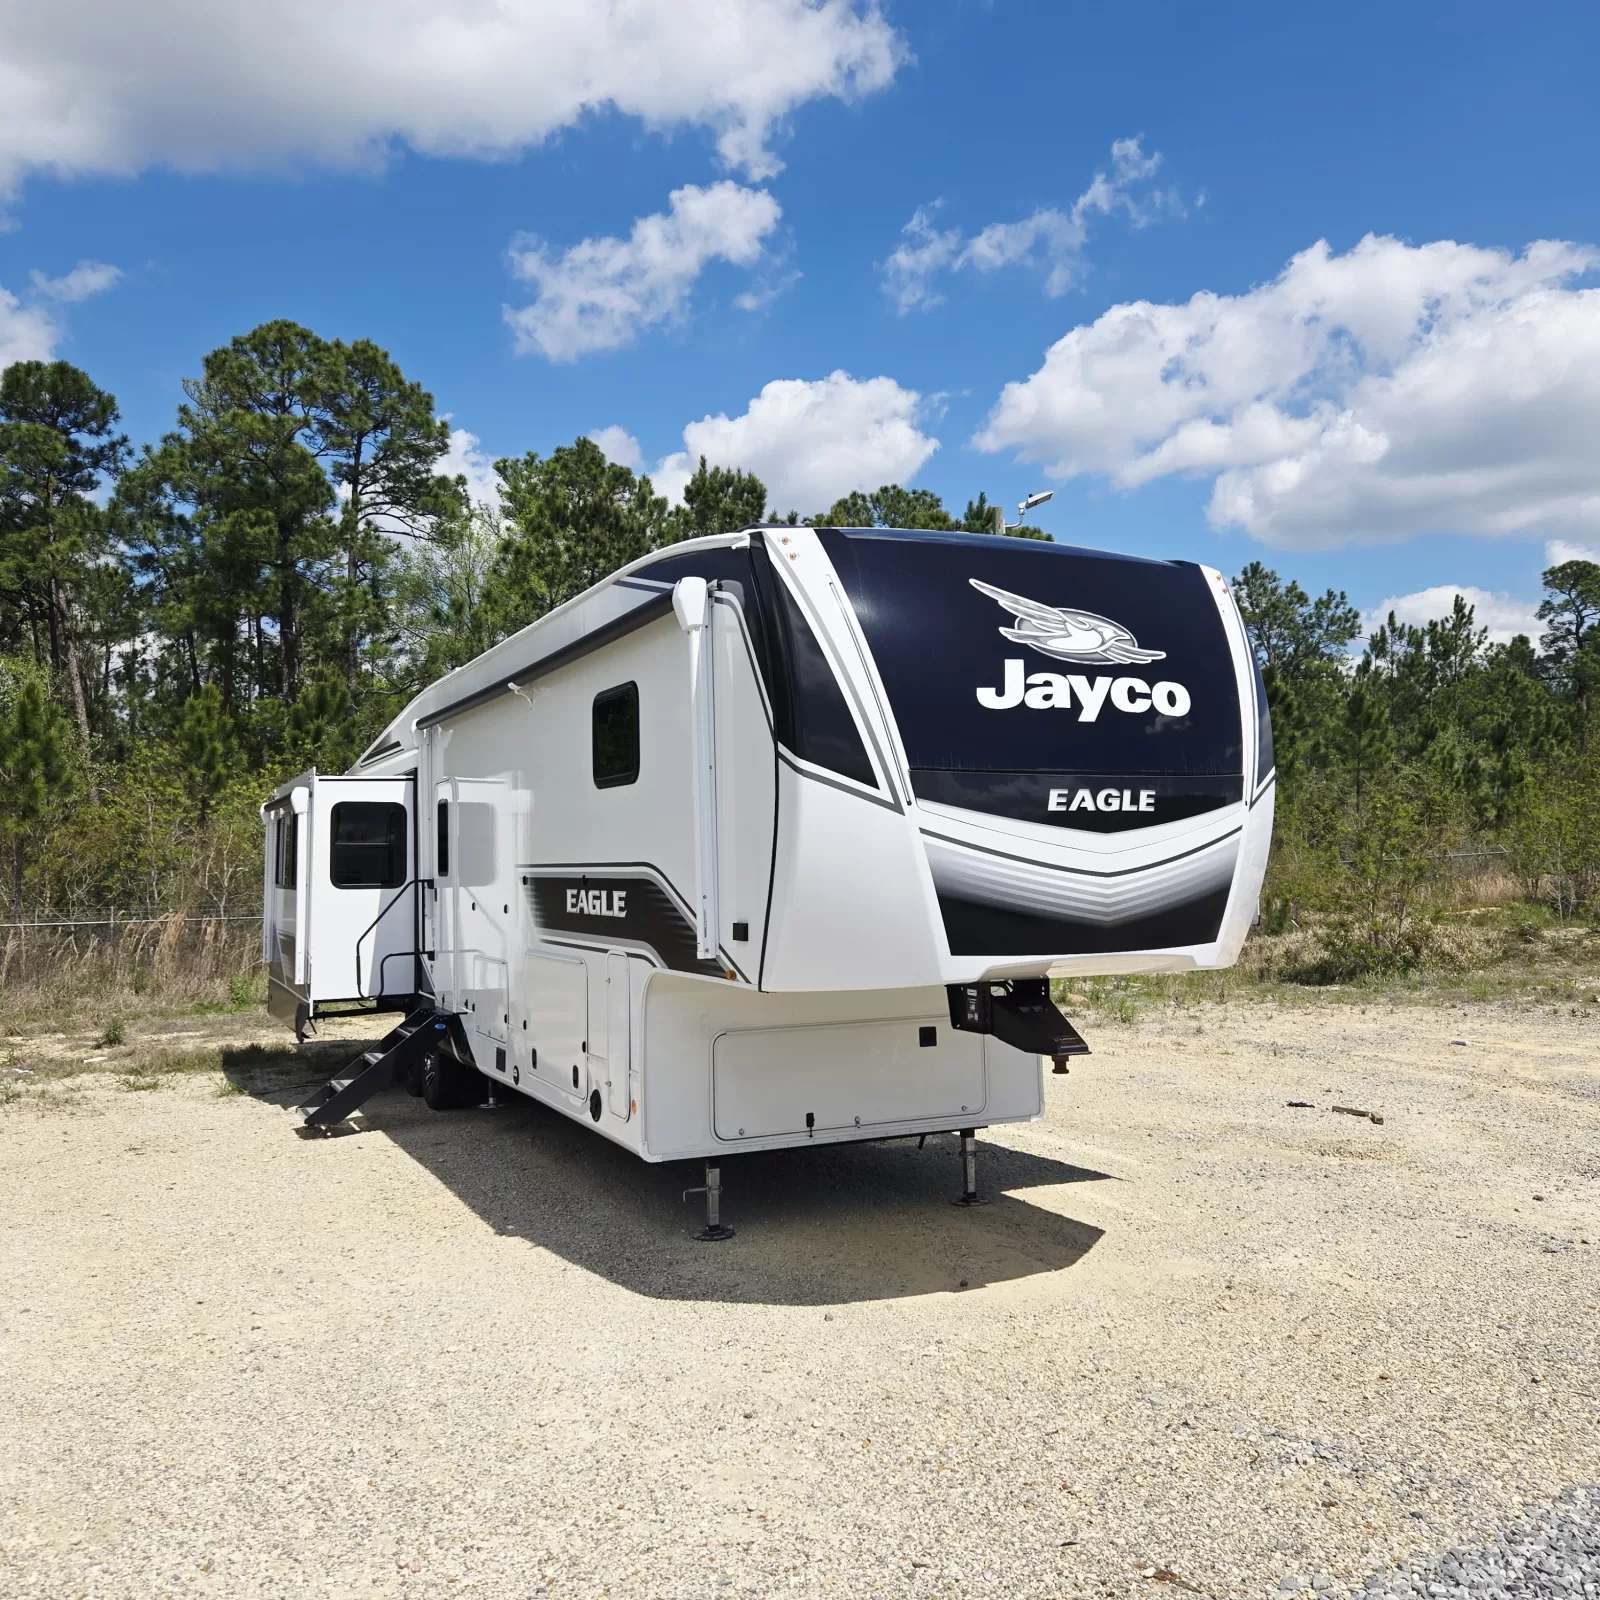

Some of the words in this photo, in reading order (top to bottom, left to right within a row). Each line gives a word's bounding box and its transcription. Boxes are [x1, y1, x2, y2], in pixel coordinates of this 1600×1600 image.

[976, 658, 1191, 723] Jayco
[1047, 788, 1156, 812] EAGLE
[566, 888, 627, 918] EAGLE
